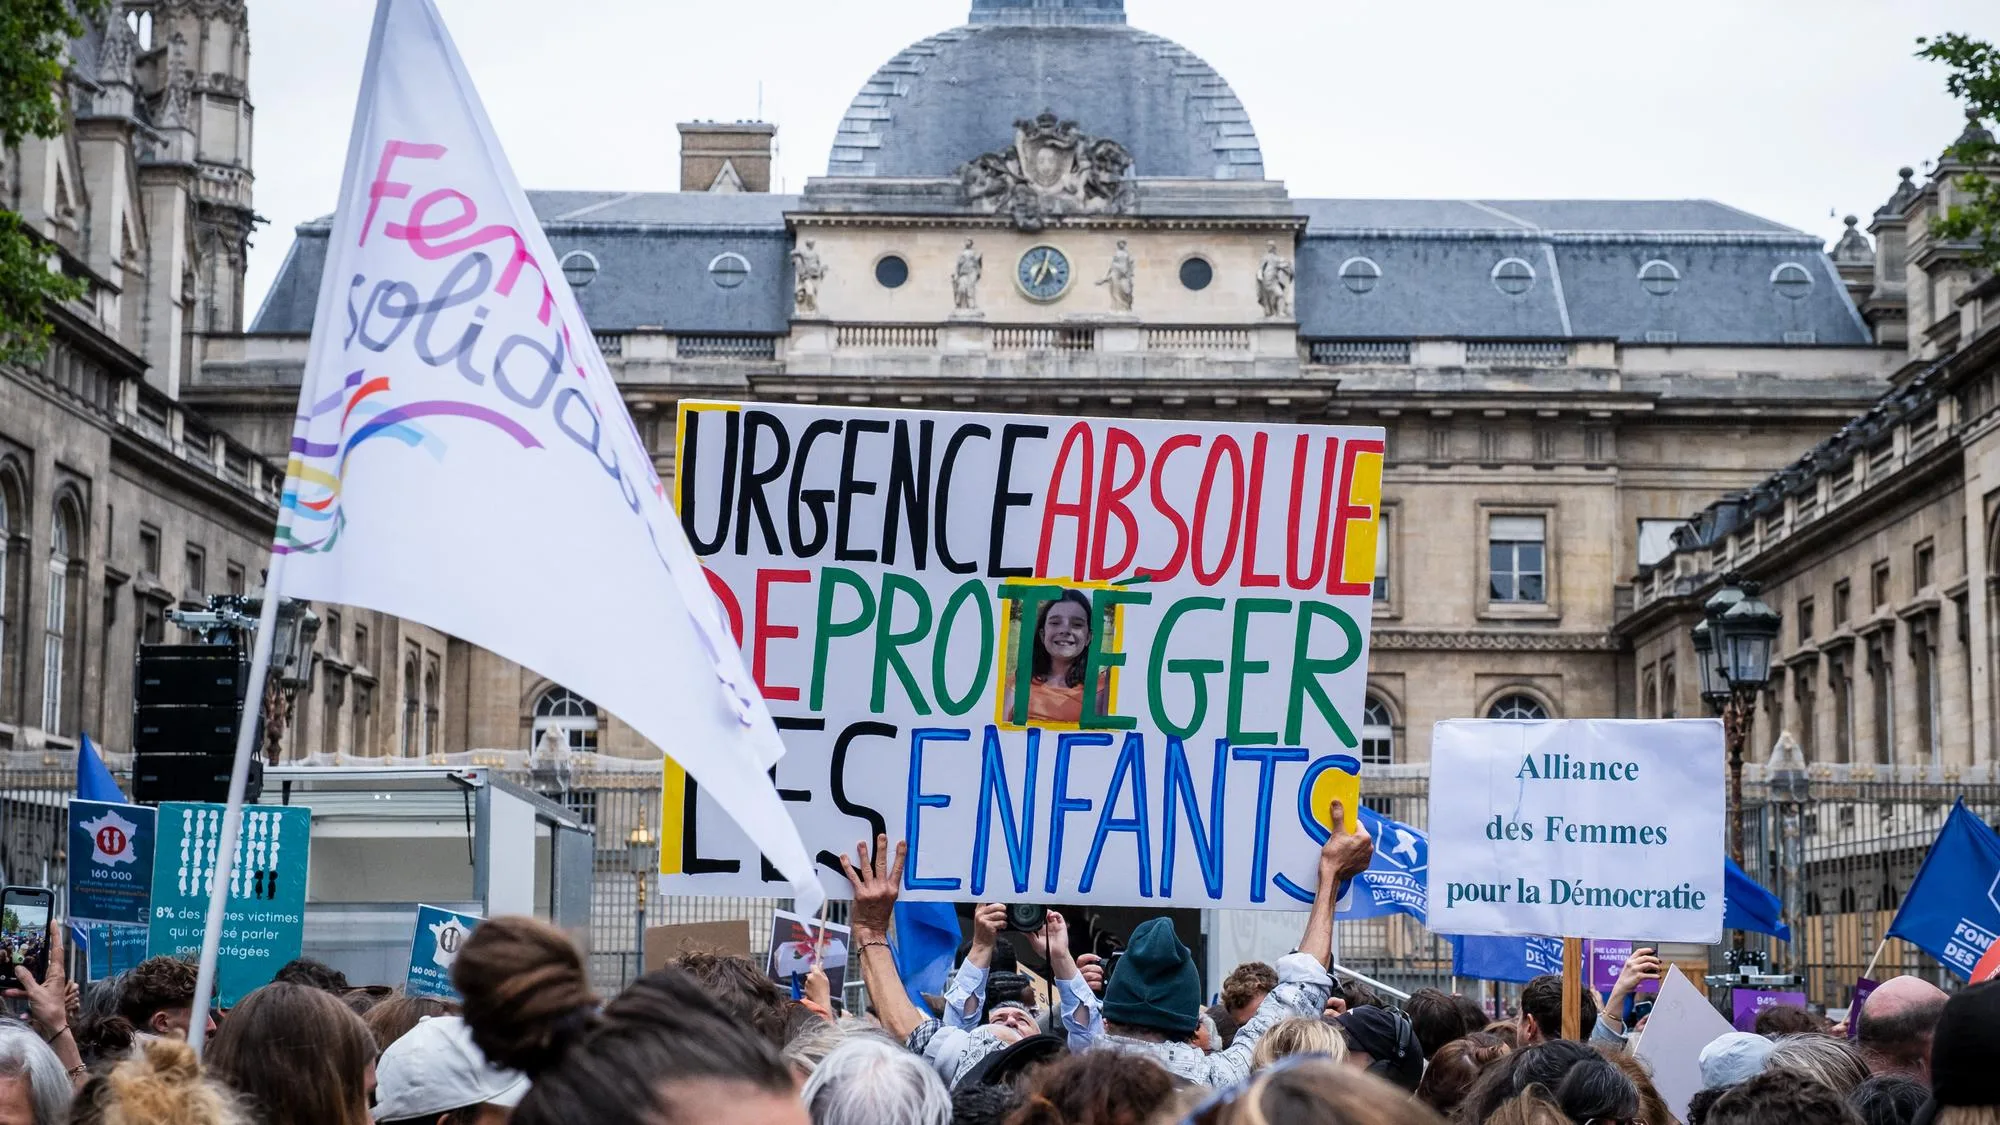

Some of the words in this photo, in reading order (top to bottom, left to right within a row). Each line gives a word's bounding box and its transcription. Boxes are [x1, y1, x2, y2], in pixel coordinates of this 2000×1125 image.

[680, 410, 1048, 578] URGENCE
[1035, 421, 1384, 596] ABSOLUE
[809, 566, 1363, 749] PROTÉGER
[1516, 753, 1639, 781] Alliance
[904, 724, 1361, 904] ENFANTS
[1486, 815, 1533, 841] des
[1544, 816, 1667, 845] Femmes
[91, 869, 108, 879] 160
[111, 871, 132, 881] 000
[1446, 881, 1511, 908] pour
[1517, 878, 1541, 904] la
[1549, 879, 1706, 910] Démocratie
[156, 907, 174, 918] 8%
[179, 907, 200, 919] des
[203, 909, 245, 924] jnes
[248, 911, 299, 924] victimes
[122, 938, 146, 947] protég
[169, 926, 188, 939] qui
[242, 928, 279, 942] parler
[217, 945, 270, 960] otégées
[1943, 942, 1976, 966] DES
[1756, 996, 1778, 1006] 94%
